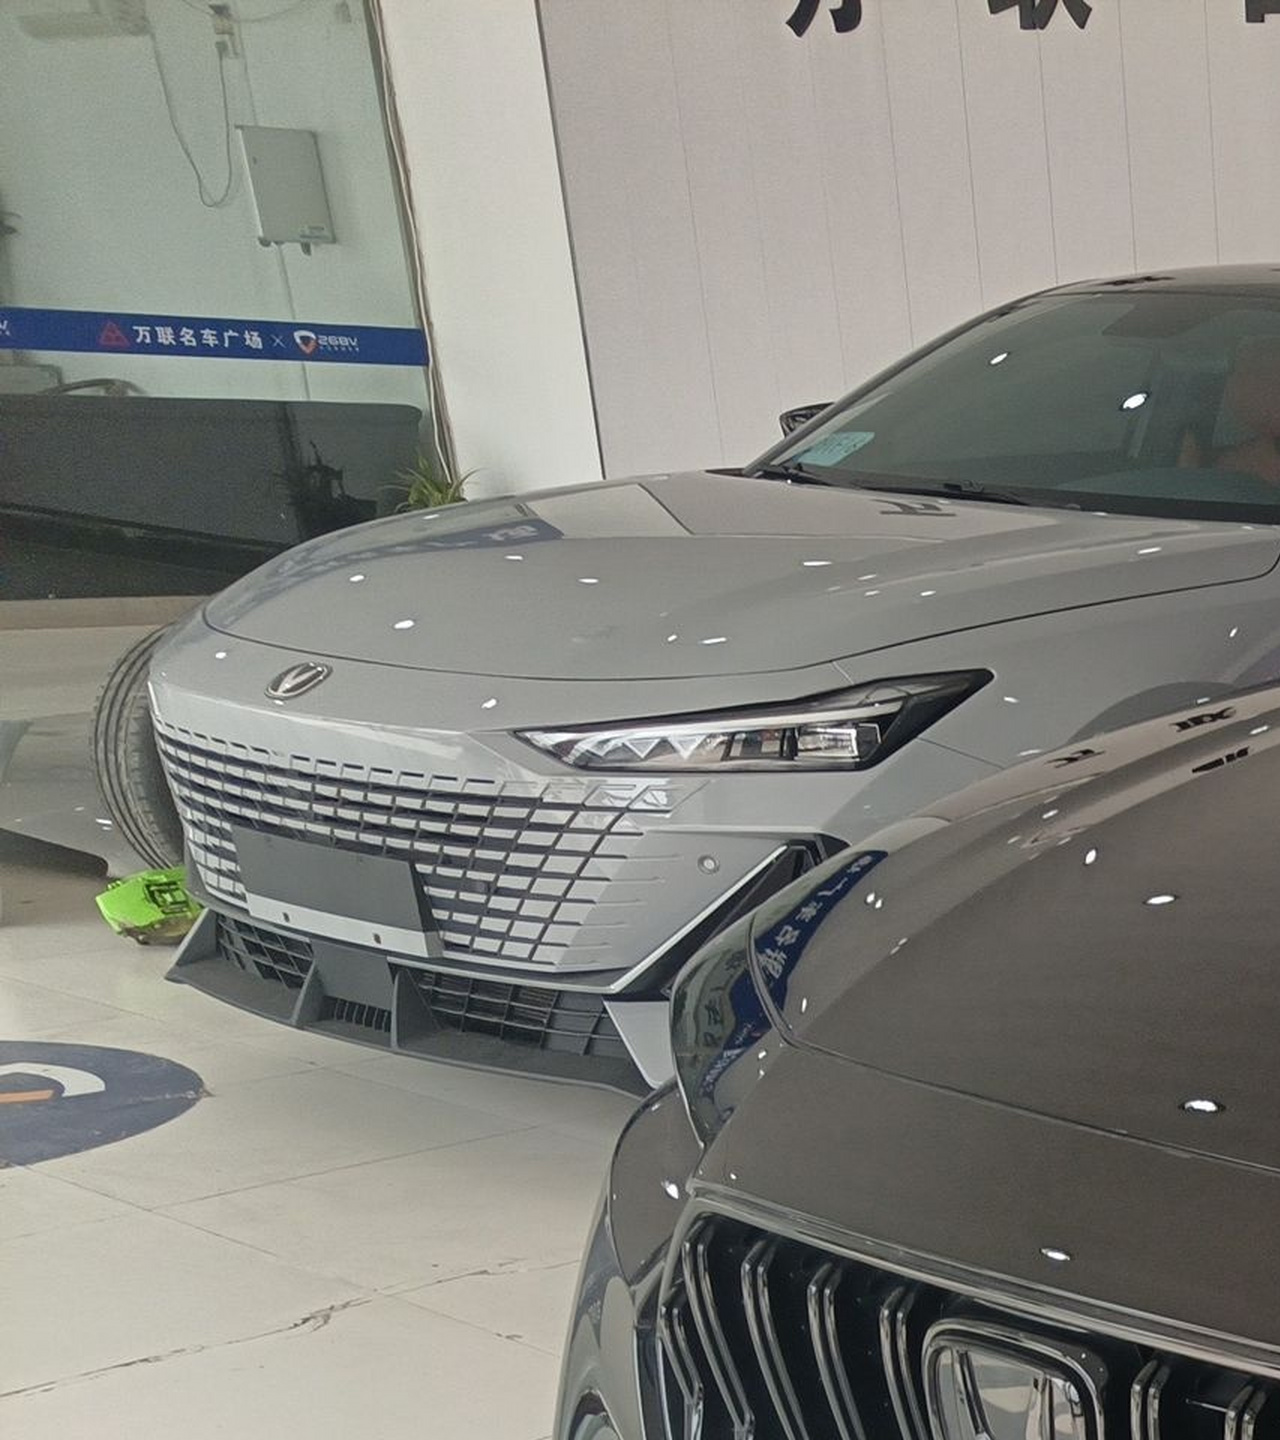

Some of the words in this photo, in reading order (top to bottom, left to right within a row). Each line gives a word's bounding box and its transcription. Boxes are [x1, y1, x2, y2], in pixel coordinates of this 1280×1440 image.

[132, 325, 263, 350] 万联名车广场
